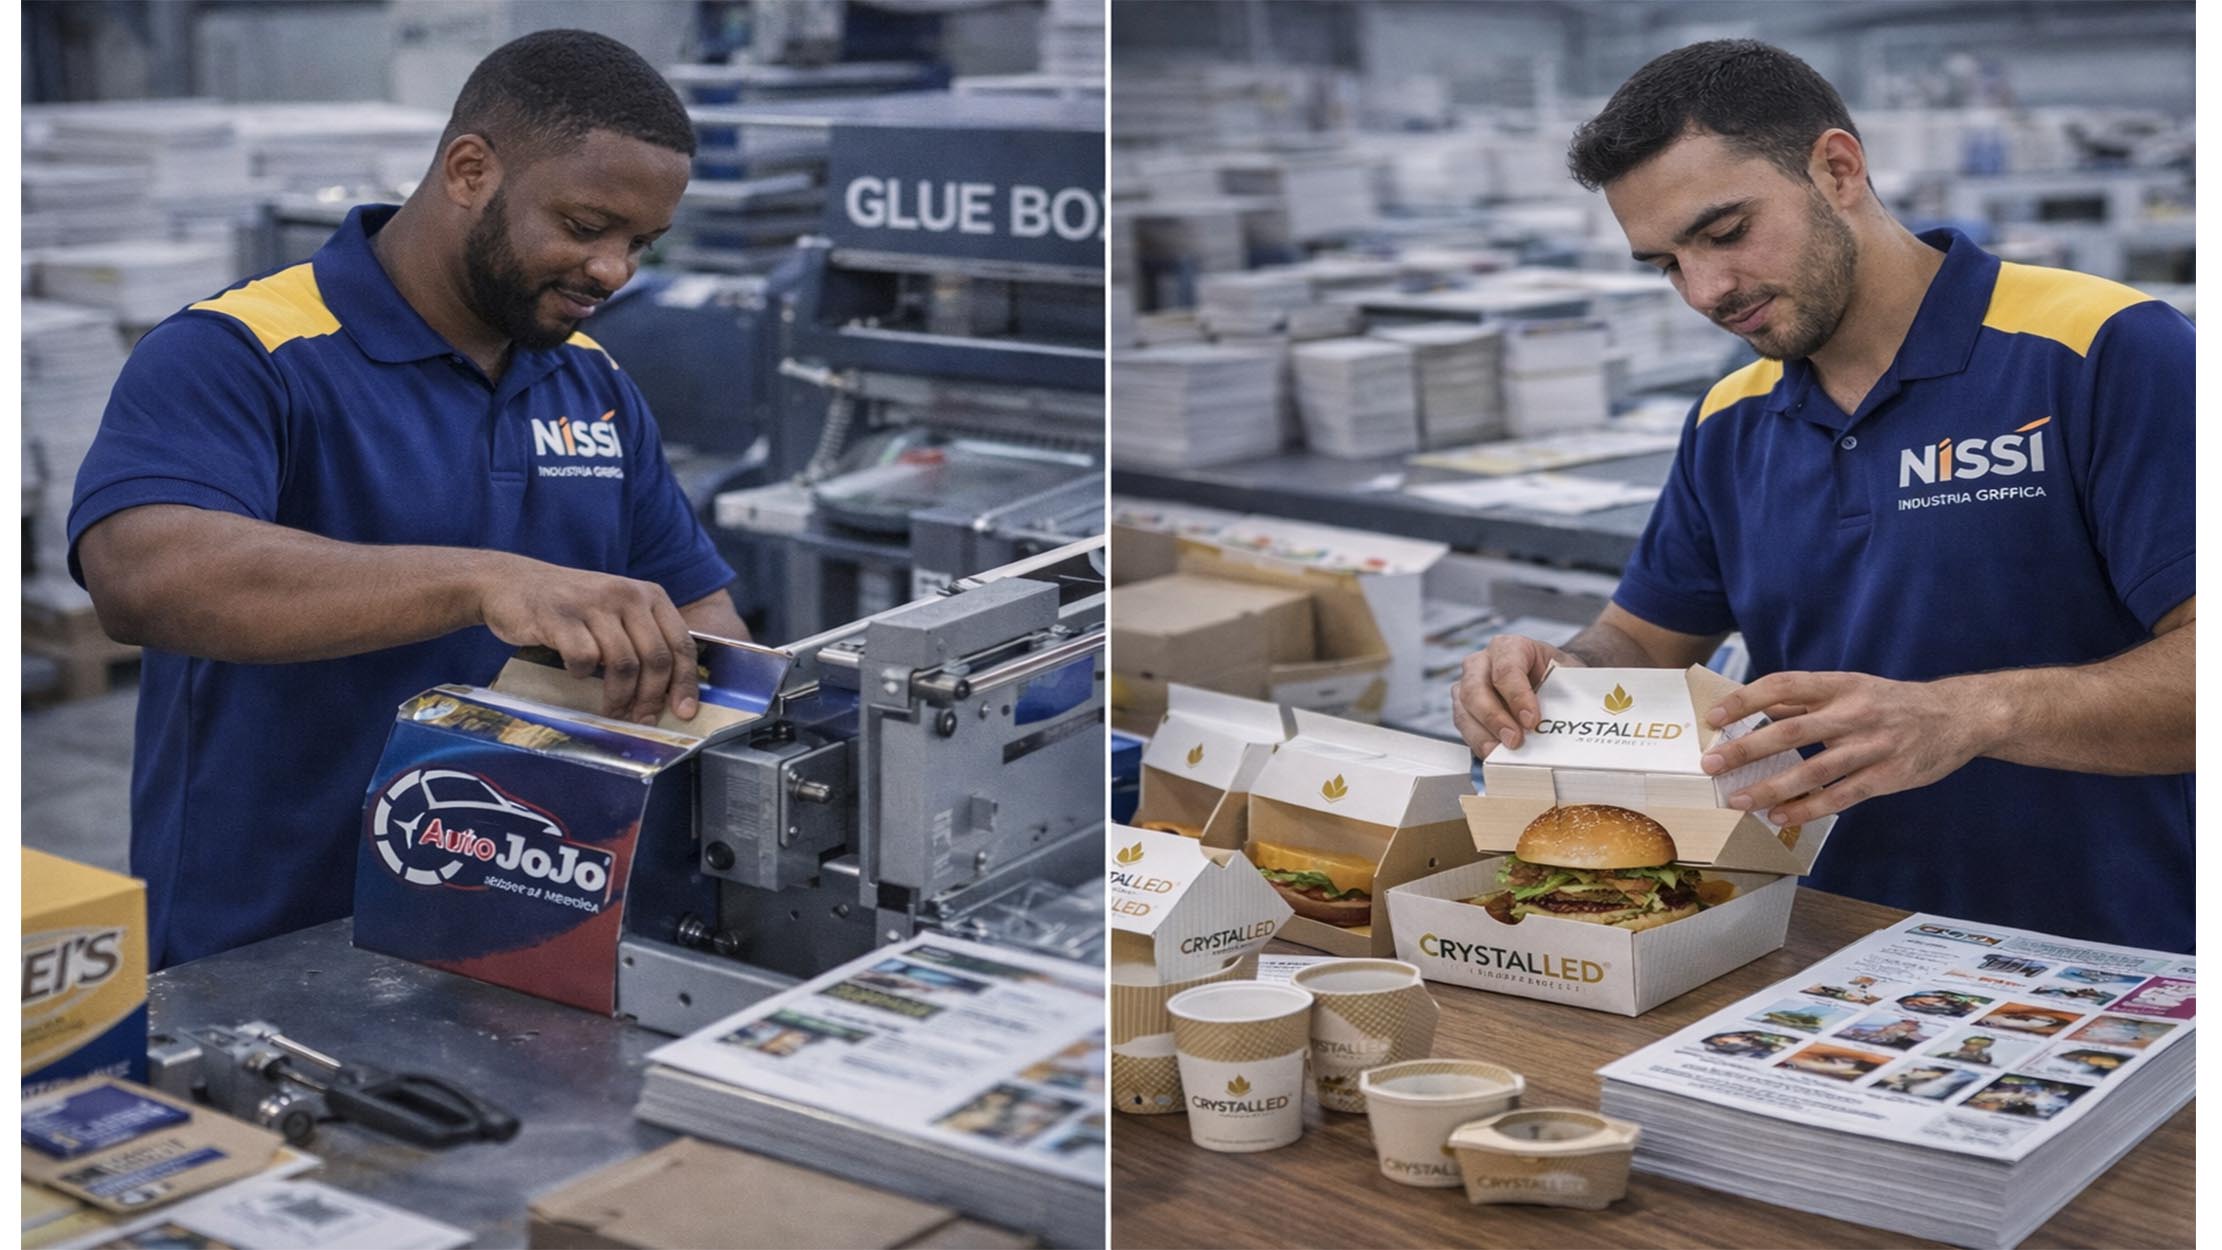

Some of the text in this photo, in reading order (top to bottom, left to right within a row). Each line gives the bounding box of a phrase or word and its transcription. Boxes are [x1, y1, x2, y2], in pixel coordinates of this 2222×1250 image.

[845, 175, 1105, 241] GLUE BO
[1534, 719, 1683, 741] CRYSTALLED
[1180, 919, 1276, 955] CRYSTALLED
[1419, 932, 1604, 984] CRYSTALLED
[1191, 1095, 1289, 1113] CRYSTALLED
